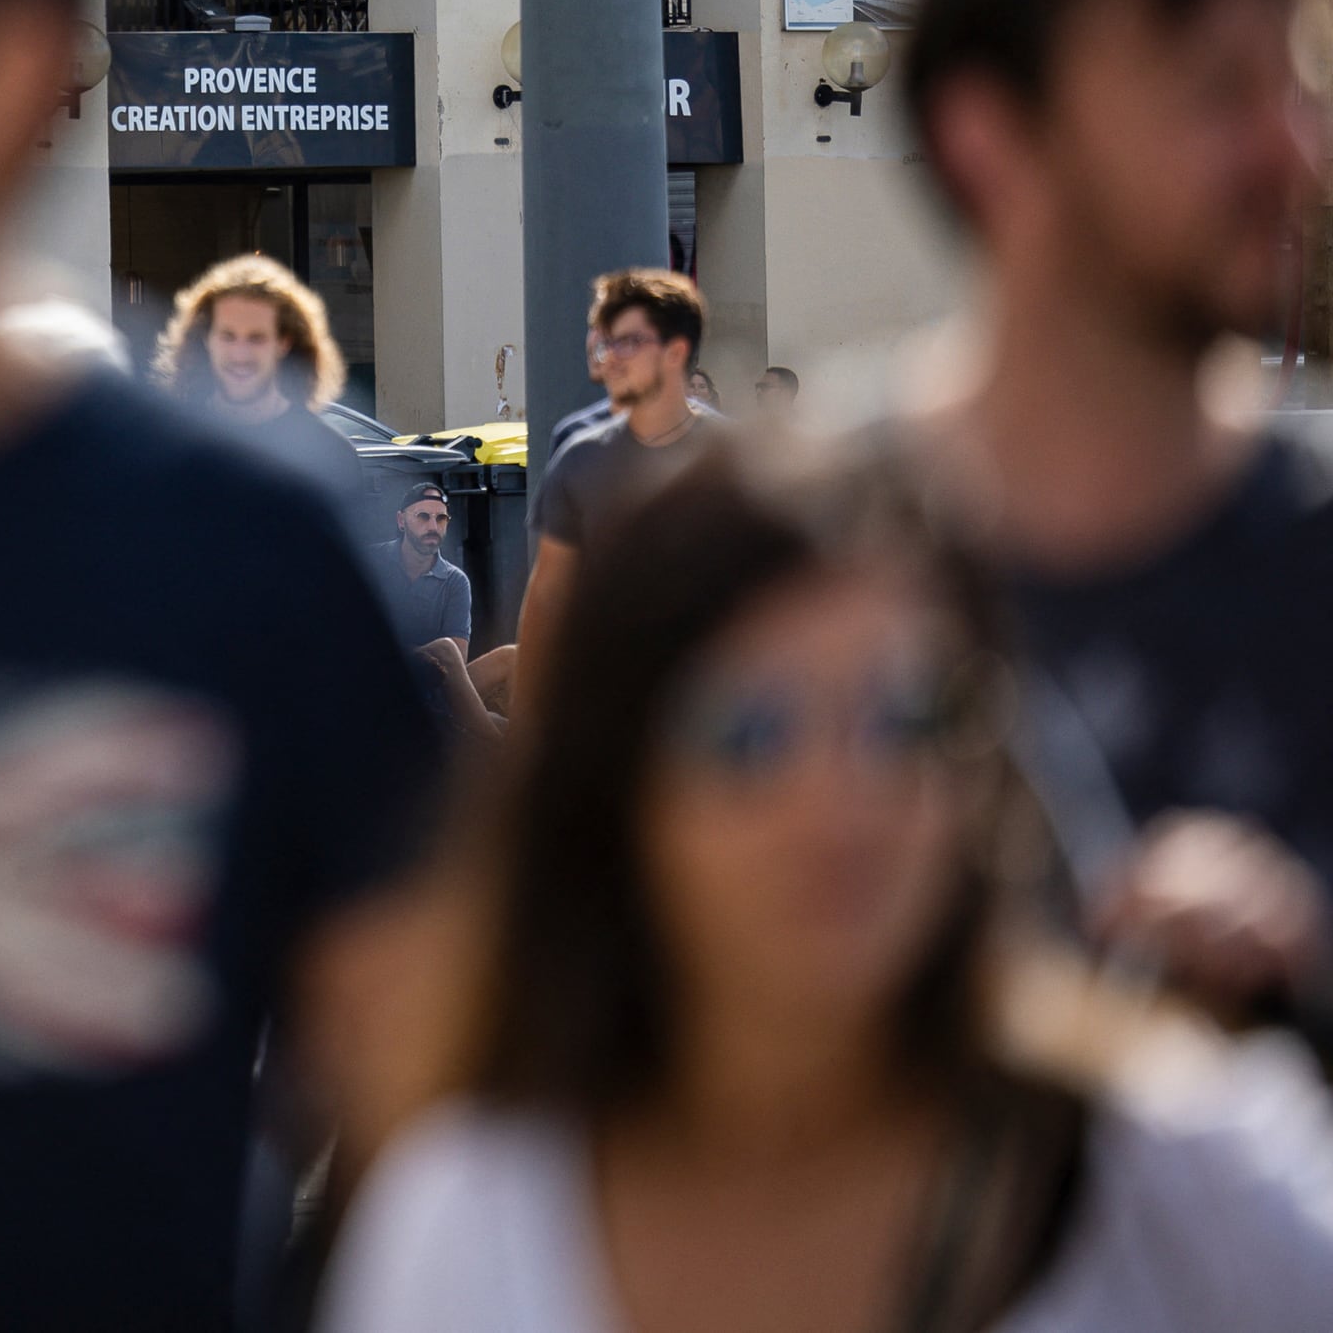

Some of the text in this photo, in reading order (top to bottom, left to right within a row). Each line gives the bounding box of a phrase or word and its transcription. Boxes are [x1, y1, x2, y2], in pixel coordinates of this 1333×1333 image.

[184, 67, 317, 94] PROVENCE
[111, 104, 389, 132] CREATION ENTREPRISE
